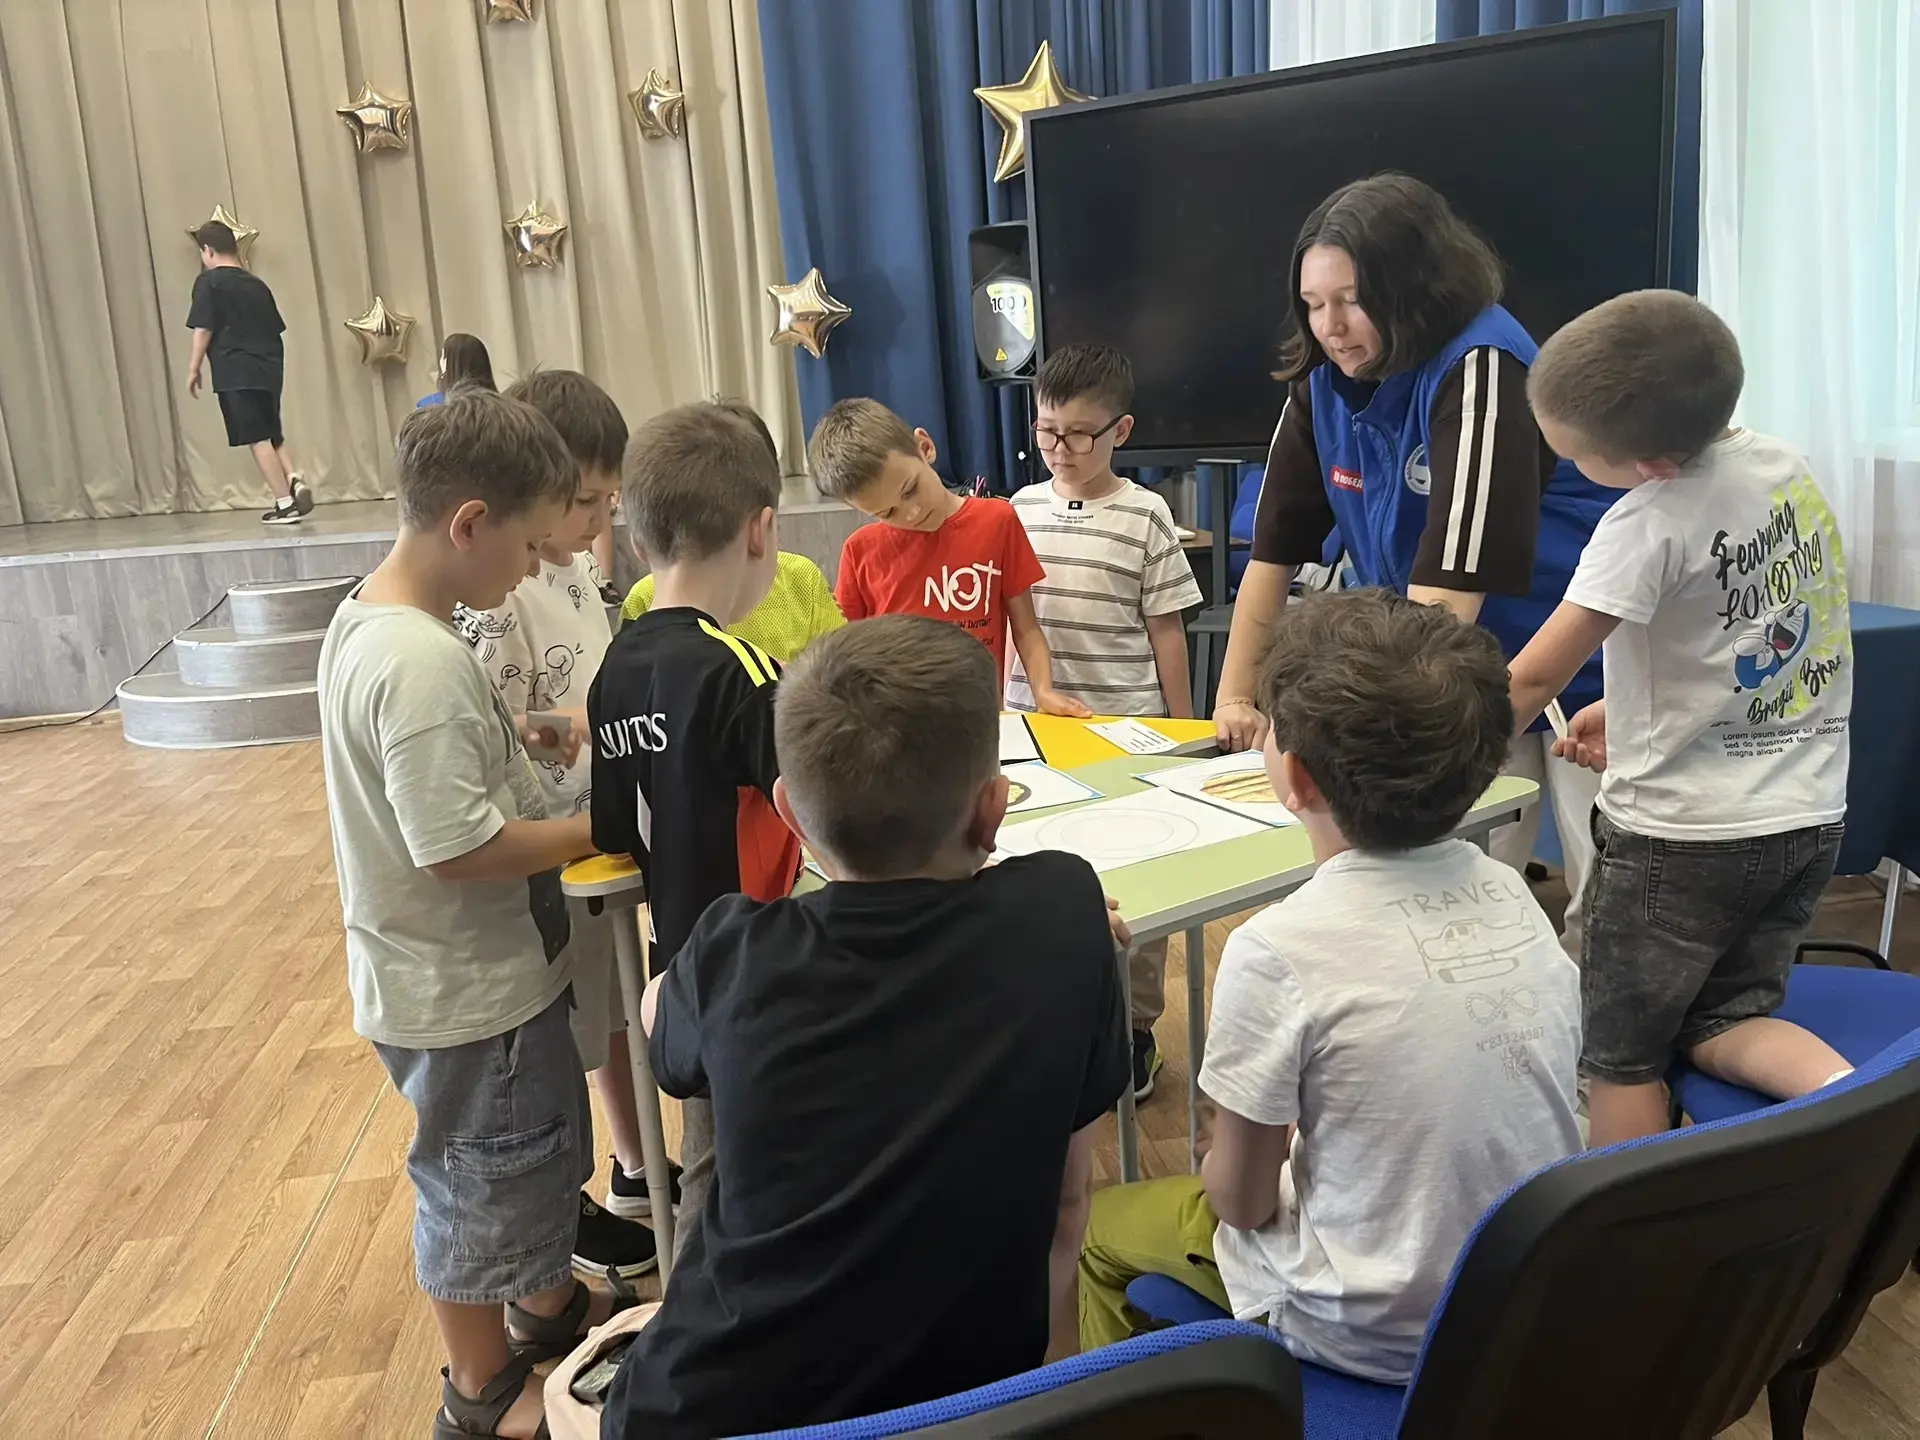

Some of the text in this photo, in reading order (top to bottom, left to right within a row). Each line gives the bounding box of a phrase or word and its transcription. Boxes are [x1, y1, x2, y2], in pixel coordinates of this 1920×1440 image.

[924, 560, 1002, 616] NOT
[1722, 731, 1748, 741] Lorem
[1751, 731, 1775, 740] ipsum
[1778, 728, 1800, 737] dolor
[1723, 741, 1739, 749] sed
[1743, 740, 1753, 748] do
[1756, 737, 1793, 748] eiusmod
[1727, 750, 1754, 758] magna
[1386, 880, 1521, 918] TRAVEL
